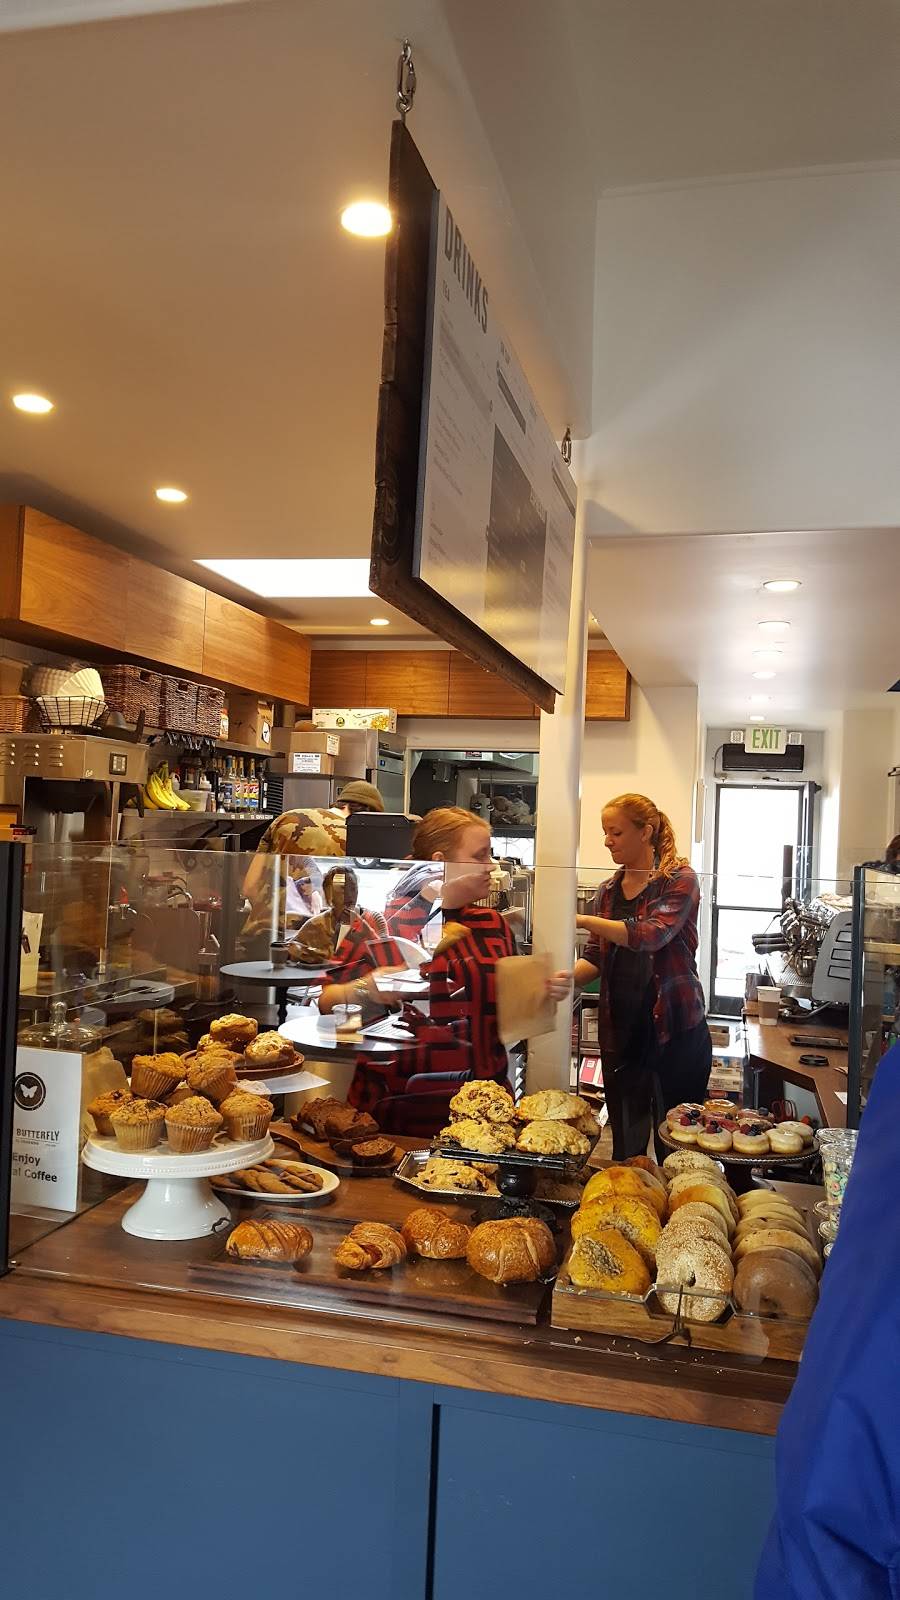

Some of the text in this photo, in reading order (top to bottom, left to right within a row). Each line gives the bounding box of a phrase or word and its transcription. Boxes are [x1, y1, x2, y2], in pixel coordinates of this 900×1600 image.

[444, 205, 489, 334] DRINKS
[752, 728, 781, 749] EXIT
[16, 1128, 60, 1141] BUTTERFLY
[12, 1152, 41, 1166] Enjoy
[24, 1169, 58, 1182] Coffee
